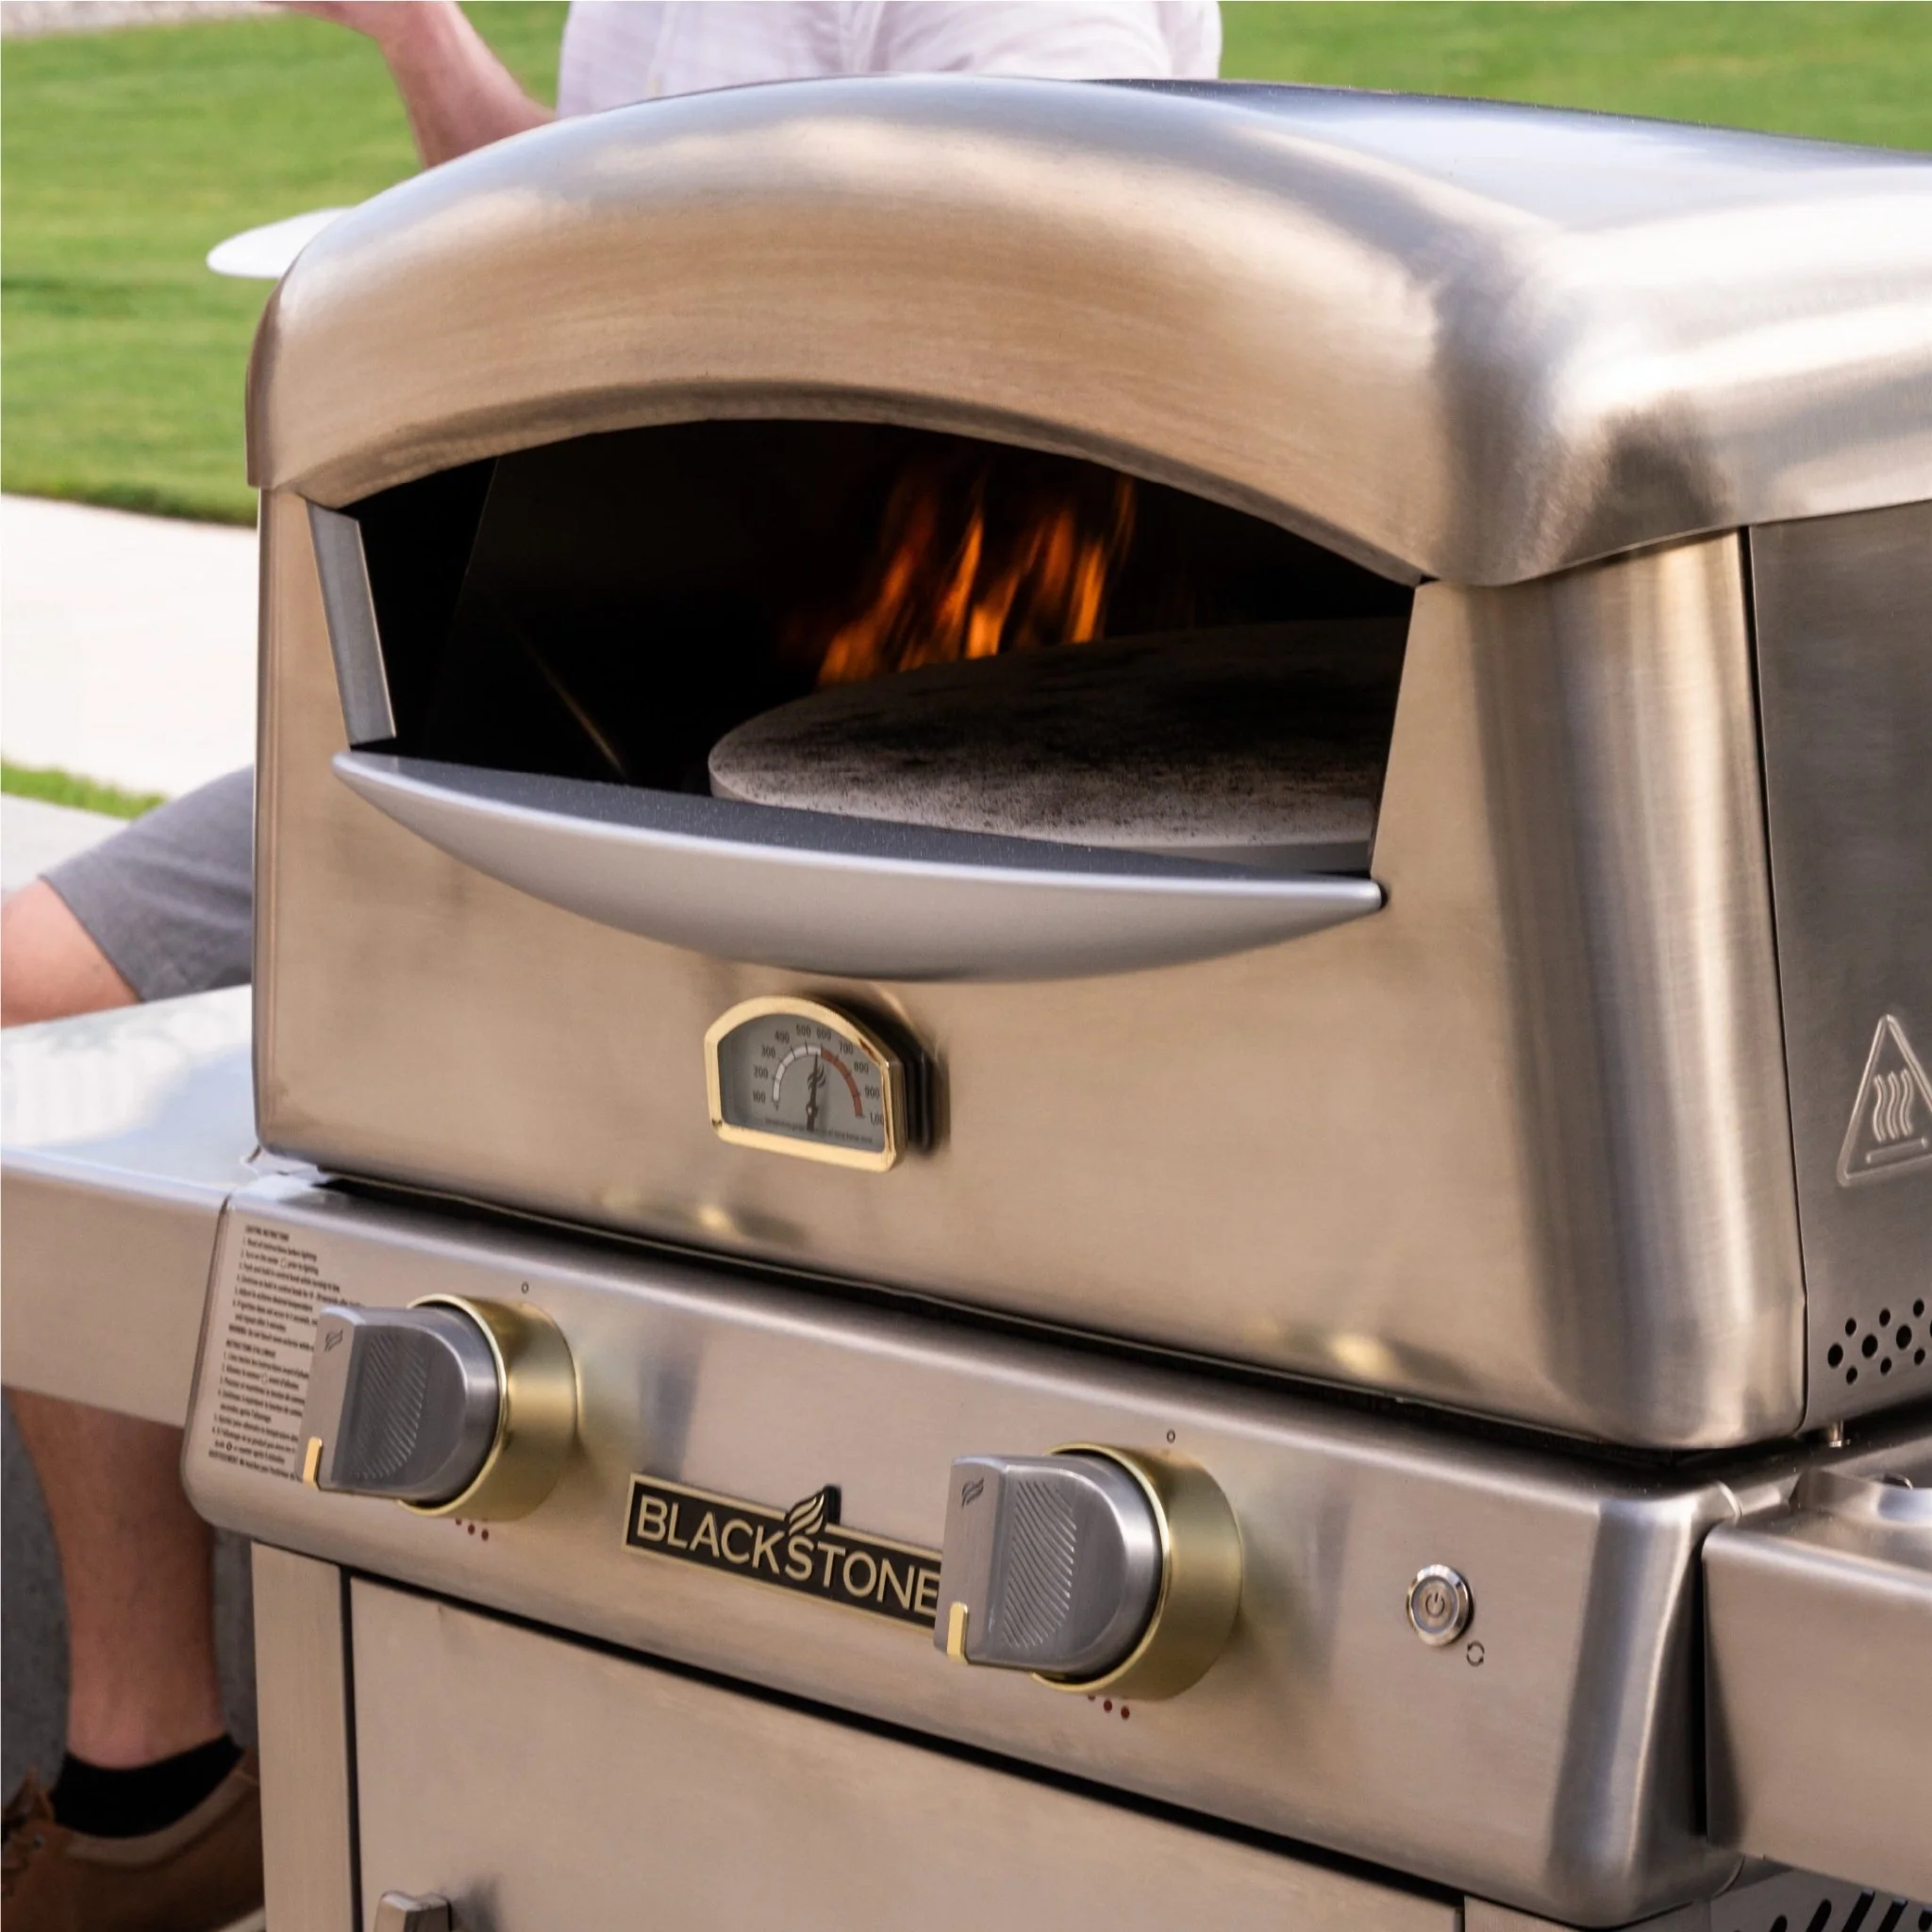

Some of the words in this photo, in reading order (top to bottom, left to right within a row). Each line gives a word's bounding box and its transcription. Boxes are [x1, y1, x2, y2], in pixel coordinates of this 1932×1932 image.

[774, 1030, 791, 1044] 400
[796, 1024, 811, 1037] 500
[816, 1027, 832, 1041] 600
[761, 1044, 776, 1058] 300
[839, 1041, 854, 1056] 700
[753, 1064, 769, 1079] 200
[854, 1060, 870, 1074] 800
[752, 1091, 766, 1104] 100
[864, 1085, 880, 1100] 900
[636, 1493, 941, 1618] BLACKSTONE
